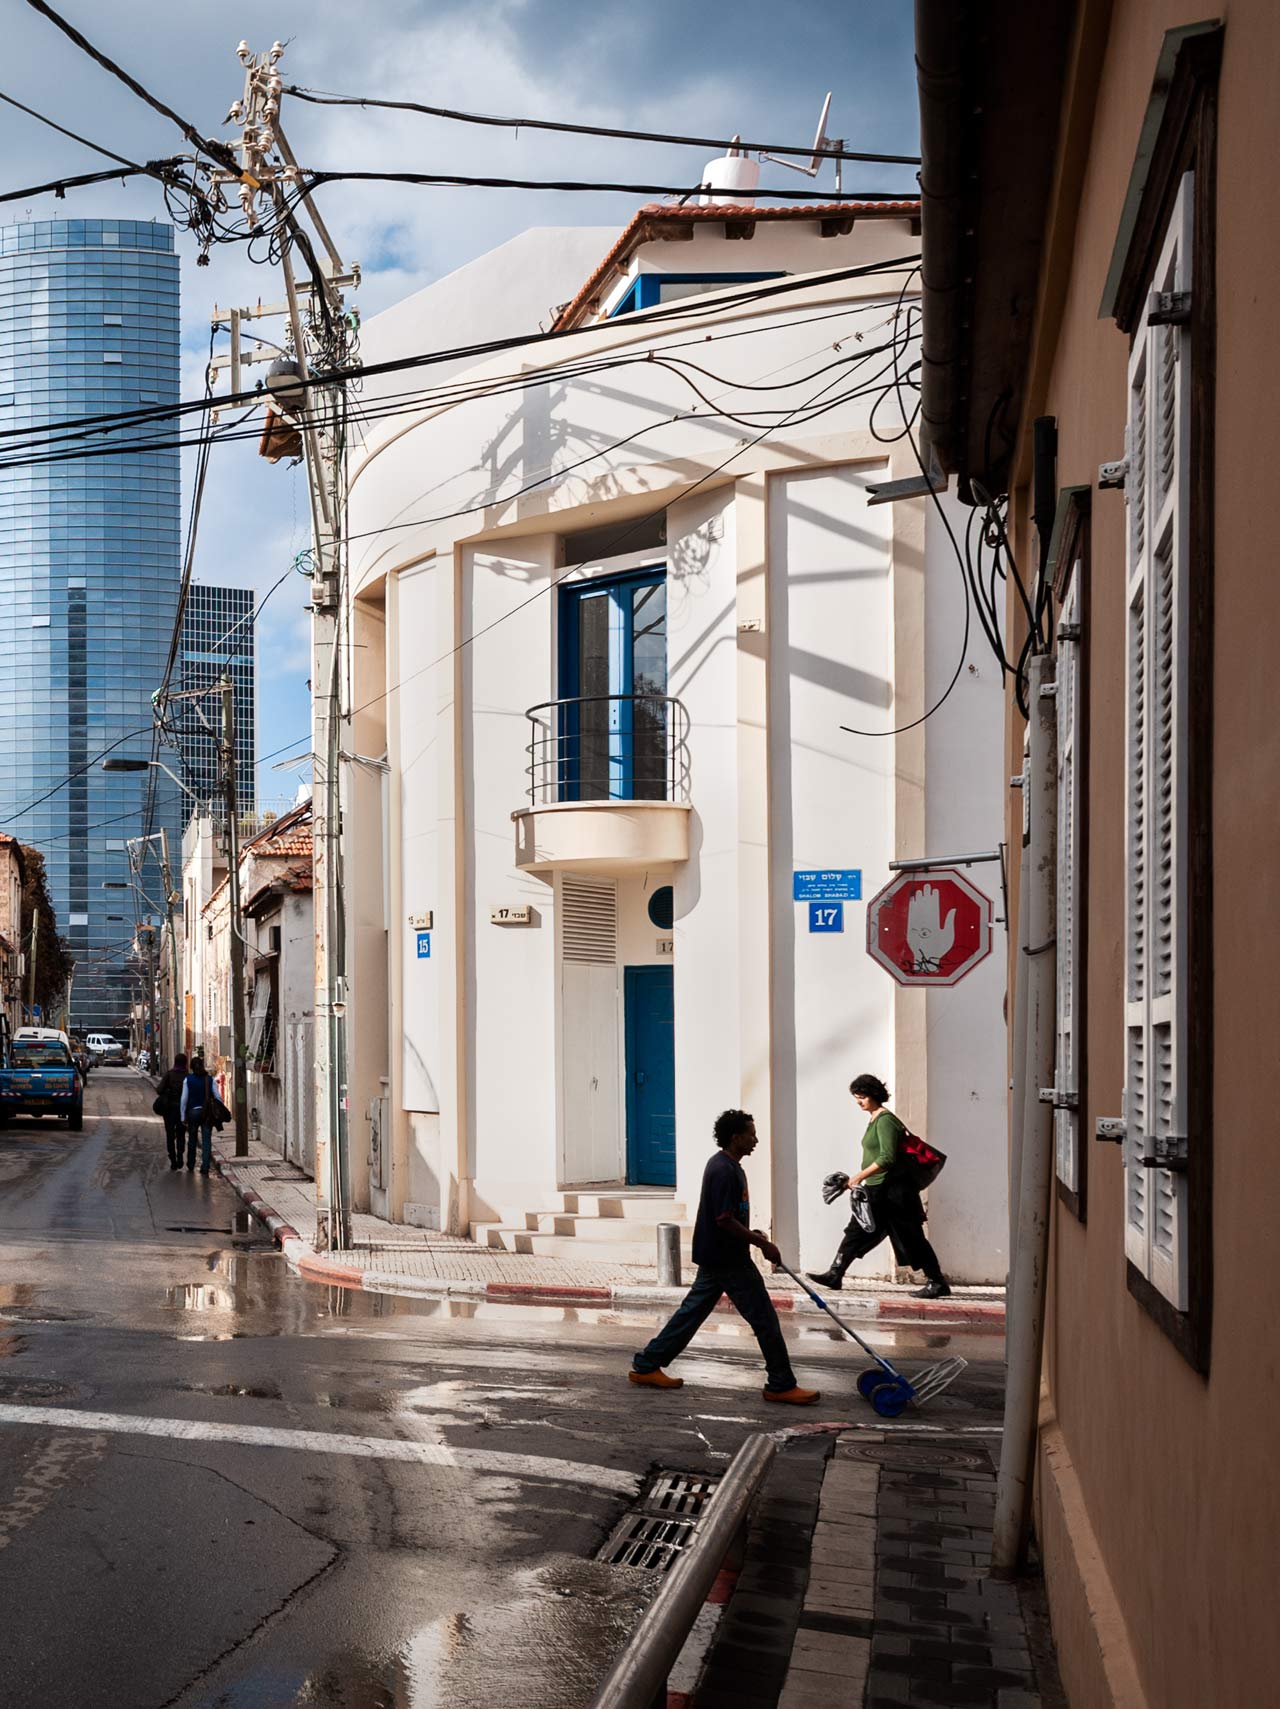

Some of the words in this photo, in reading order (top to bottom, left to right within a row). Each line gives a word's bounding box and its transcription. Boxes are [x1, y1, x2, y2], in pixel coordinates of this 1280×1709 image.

[498, 909, 509, 919] 17
[815, 909, 838, 926] 17
[418, 939, 428, 953] 15
